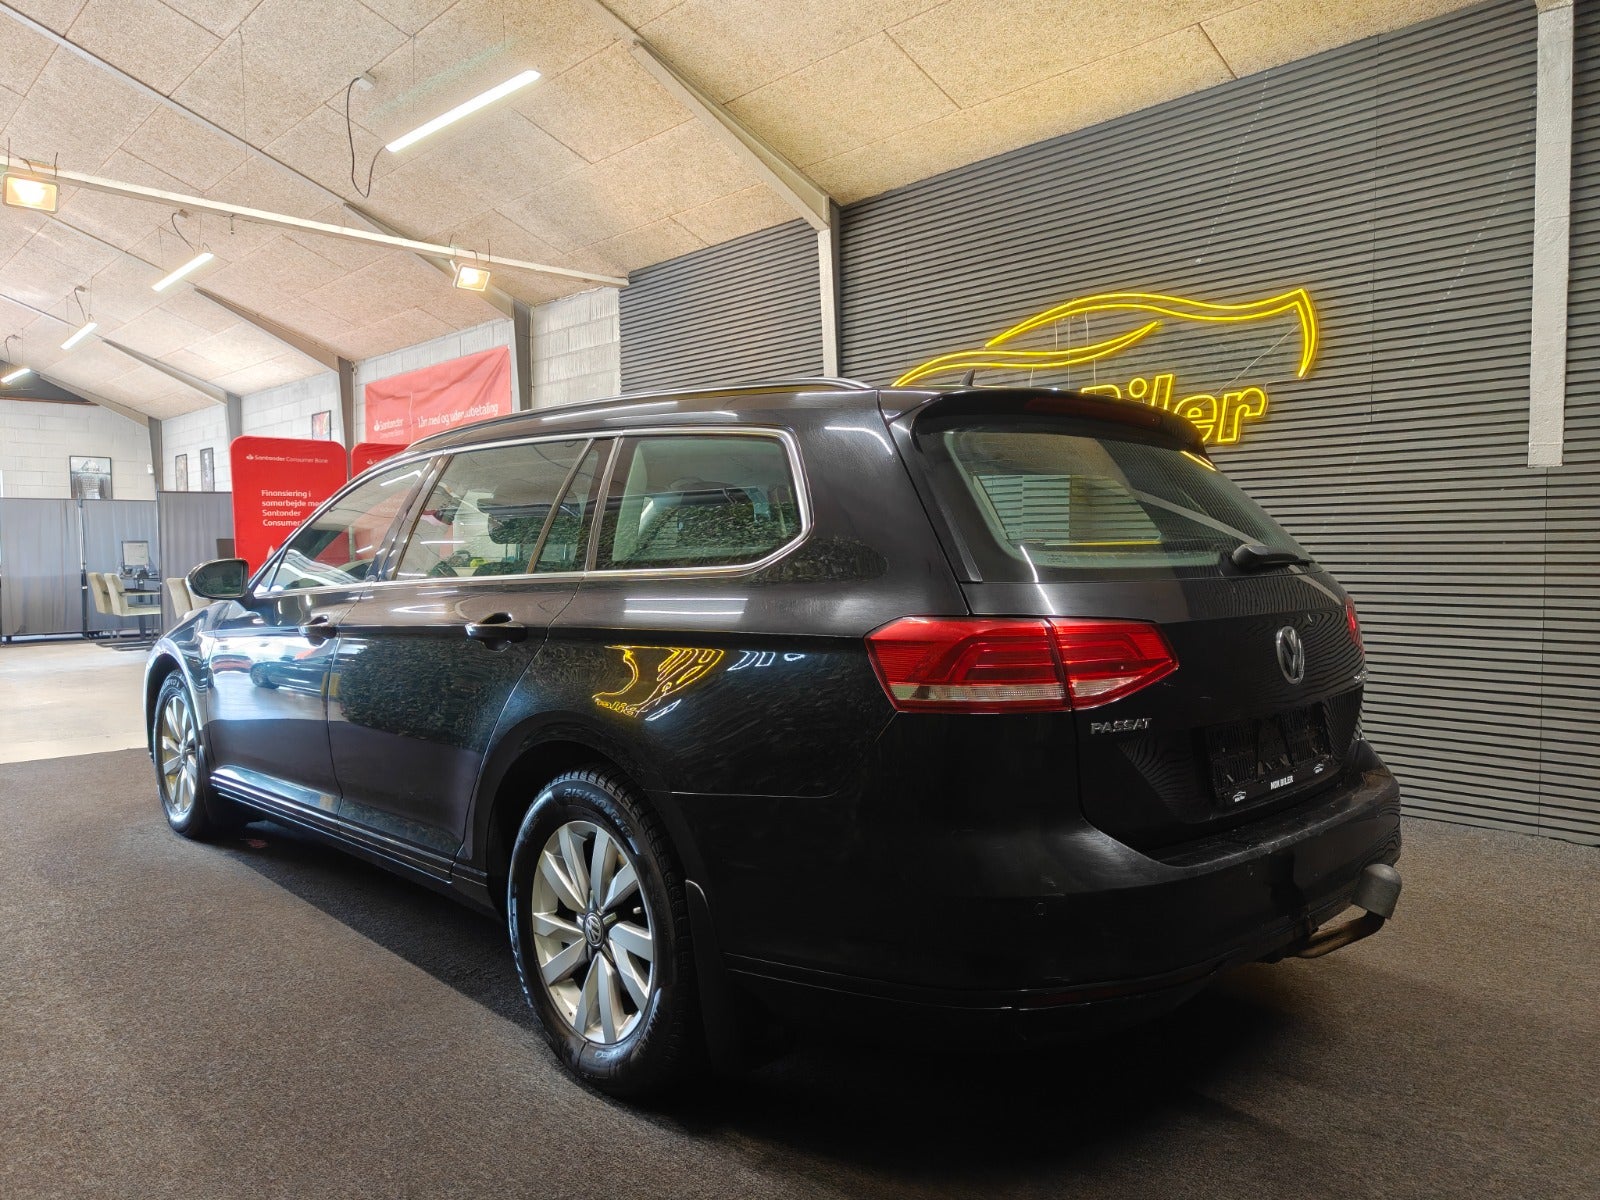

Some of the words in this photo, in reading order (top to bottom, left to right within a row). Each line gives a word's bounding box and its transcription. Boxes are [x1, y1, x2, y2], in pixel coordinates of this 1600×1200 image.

[254, 454, 285, 462] Santander
[286, 456, 314, 464] Consumer
[261, 489, 308, 499] Finansiering
[261, 500, 307, 508] samarbejde
[262, 509, 301, 517] Santander
[262, 519, 300, 527] Consumer
[1090, 717, 1153, 734] PASSAT
